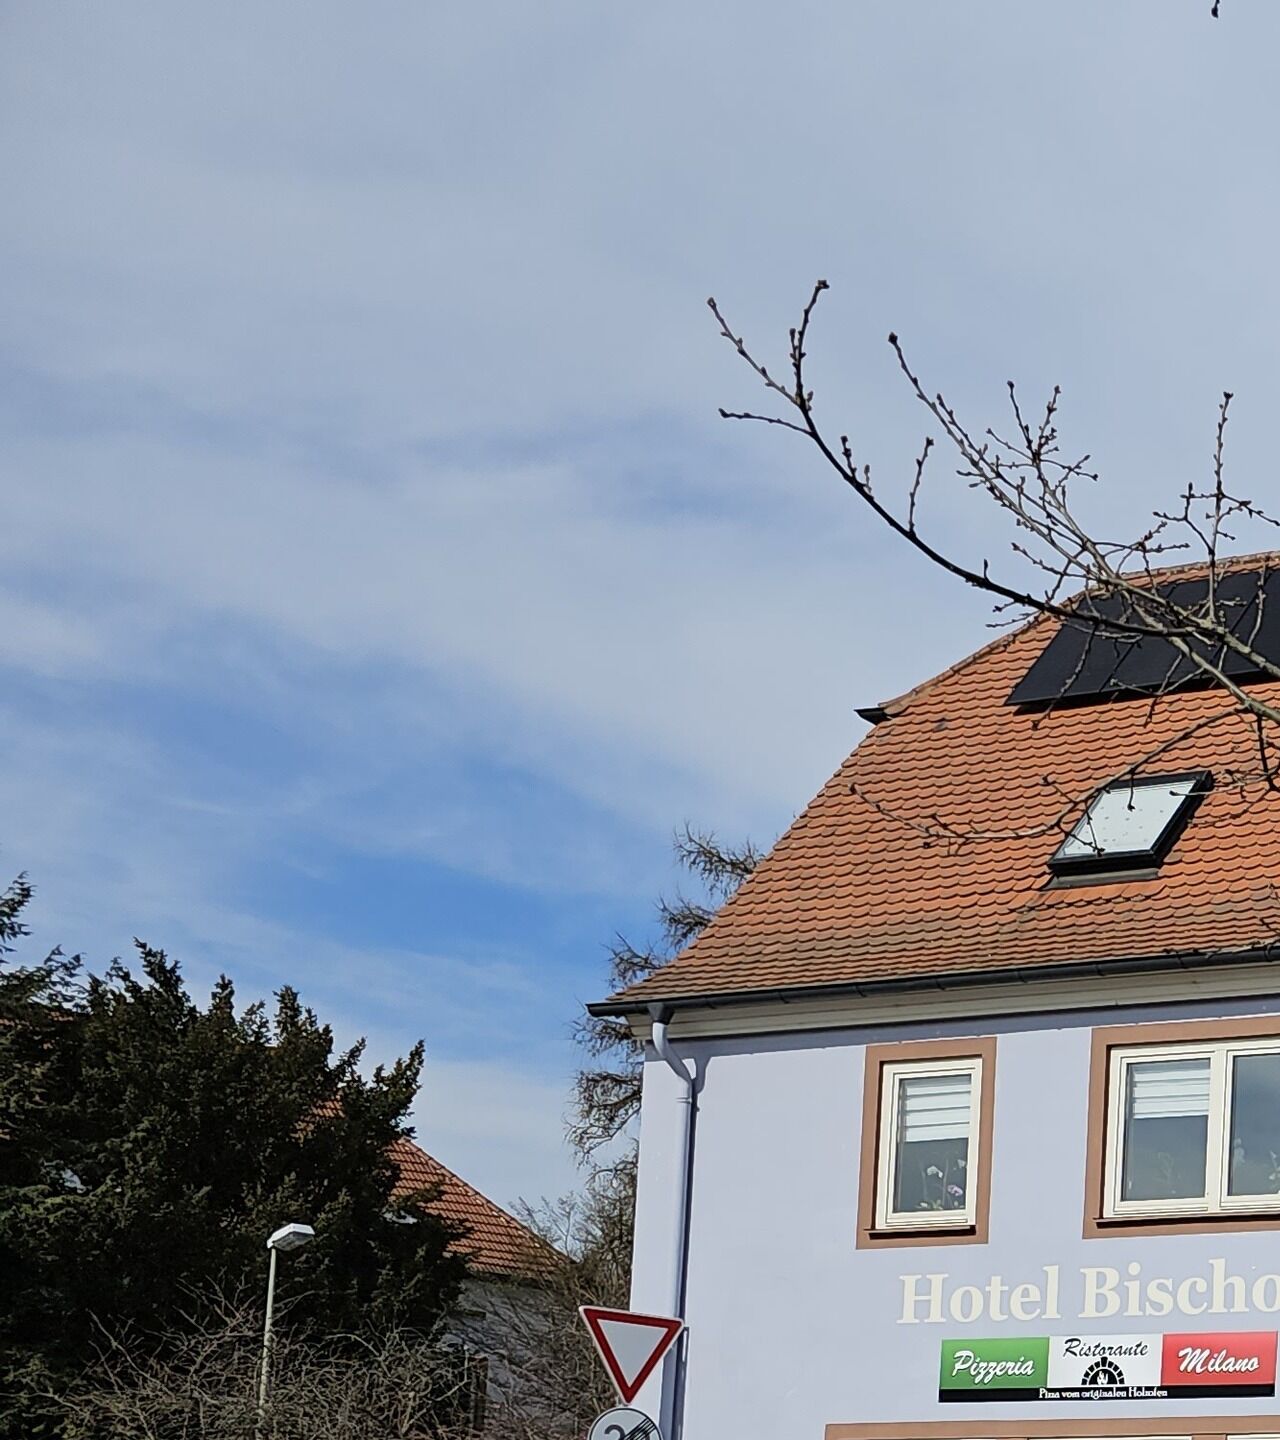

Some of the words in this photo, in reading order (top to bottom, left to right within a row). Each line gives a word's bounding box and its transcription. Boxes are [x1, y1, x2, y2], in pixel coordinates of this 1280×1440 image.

[895, 1264, 1062, 1324] Hotel
[1062, 1337, 1149, 1358] Ristorante
[1178, 1346, 1260, 1374] Milano
[951, 1349, 1036, 1384] Pizzeria
[1061, 1390, 1080, 1398] vom
